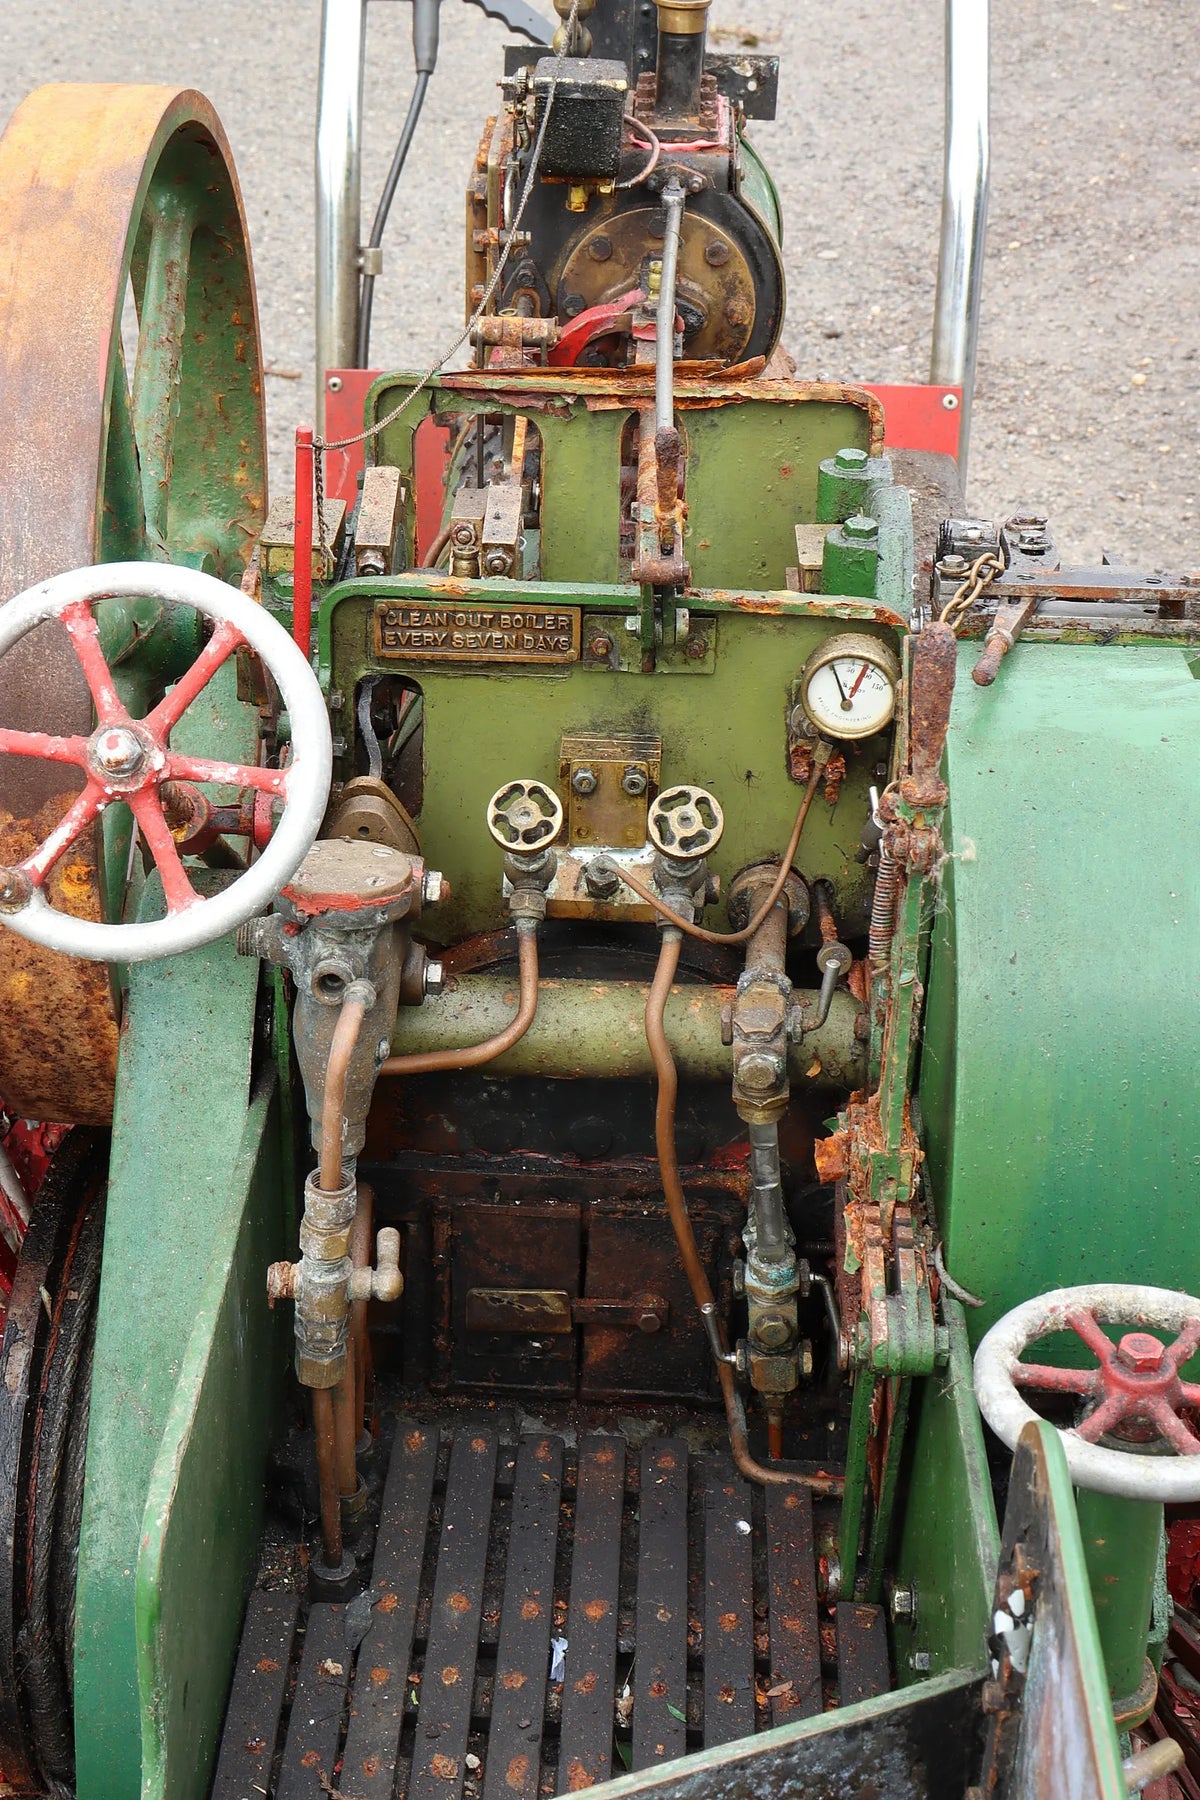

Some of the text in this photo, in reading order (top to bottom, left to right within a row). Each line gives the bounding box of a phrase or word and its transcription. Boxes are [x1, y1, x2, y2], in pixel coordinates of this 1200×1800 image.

[385, 611, 570, 630] CLEAN OUT BOILER
[385, 631, 570, 650] EVERY SEVEN DAYS
[871, 683, 884, 691] 150
